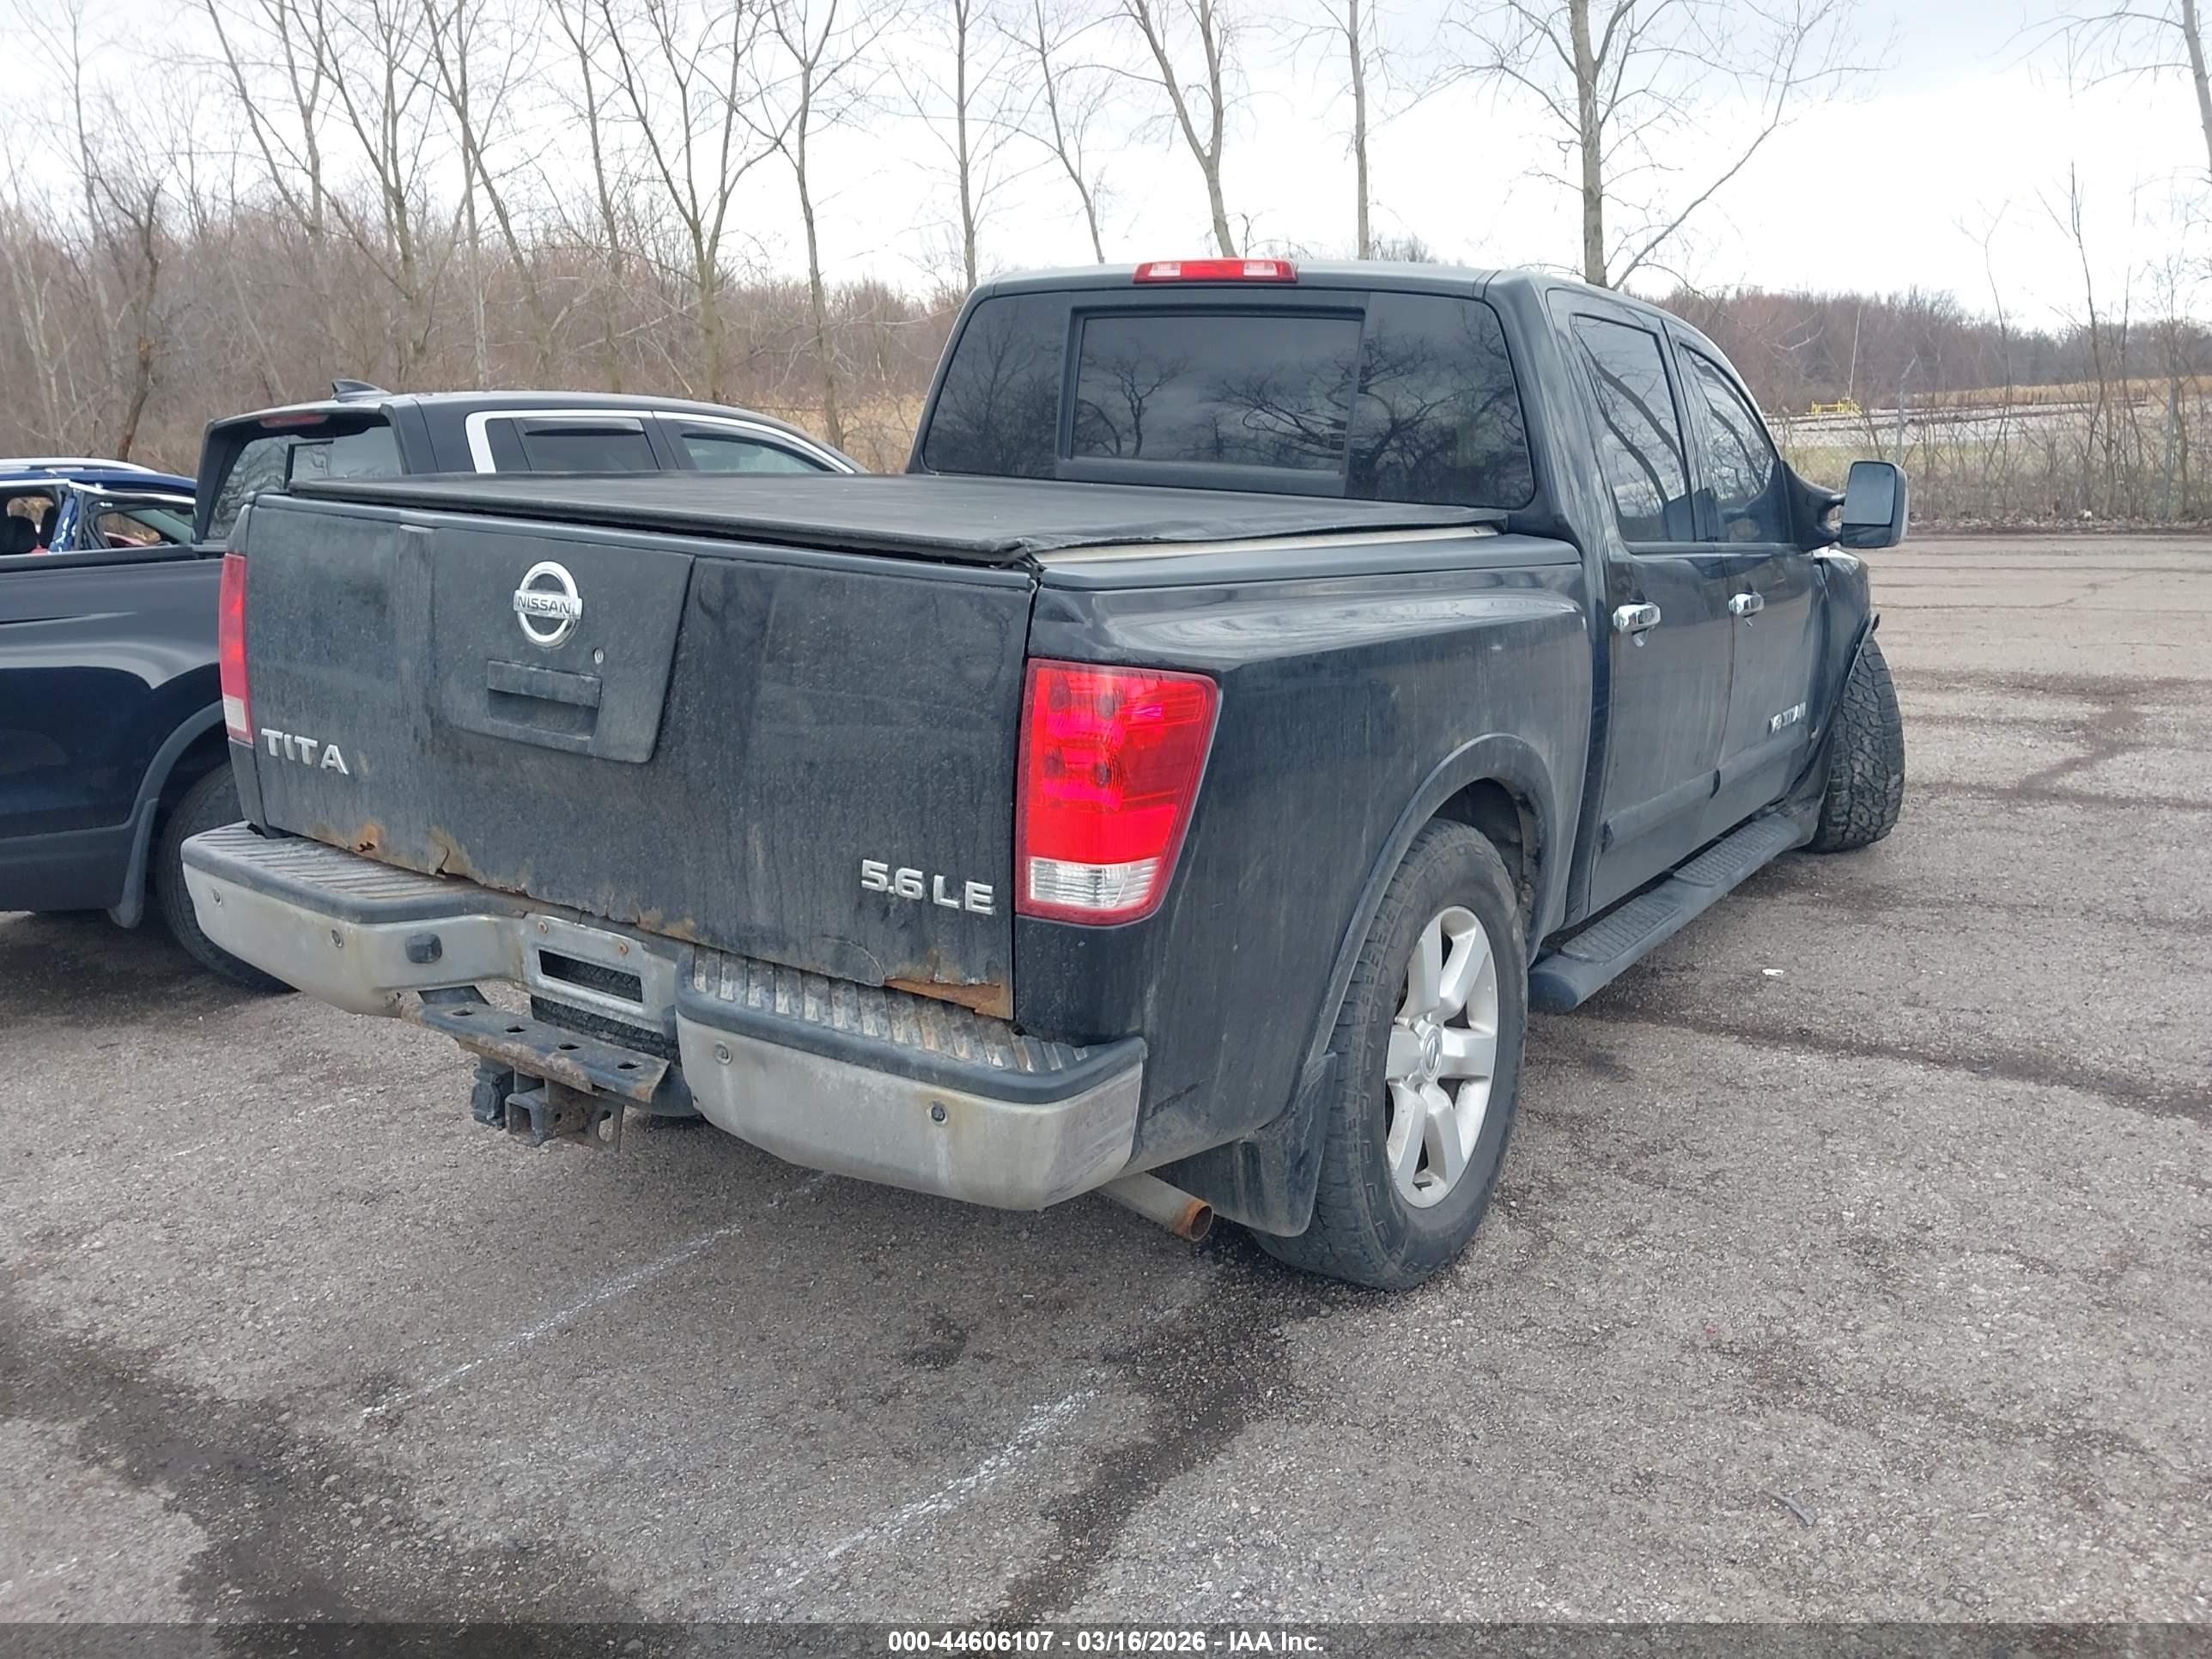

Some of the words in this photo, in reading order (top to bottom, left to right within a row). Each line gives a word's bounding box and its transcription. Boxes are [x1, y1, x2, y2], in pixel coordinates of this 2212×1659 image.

[517, 596, 571, 615] NISSAN
[260, 727, 349, 775] TITA
[860, 859, 923, 900] 5.6
[933, 874, 994, 916] LE
